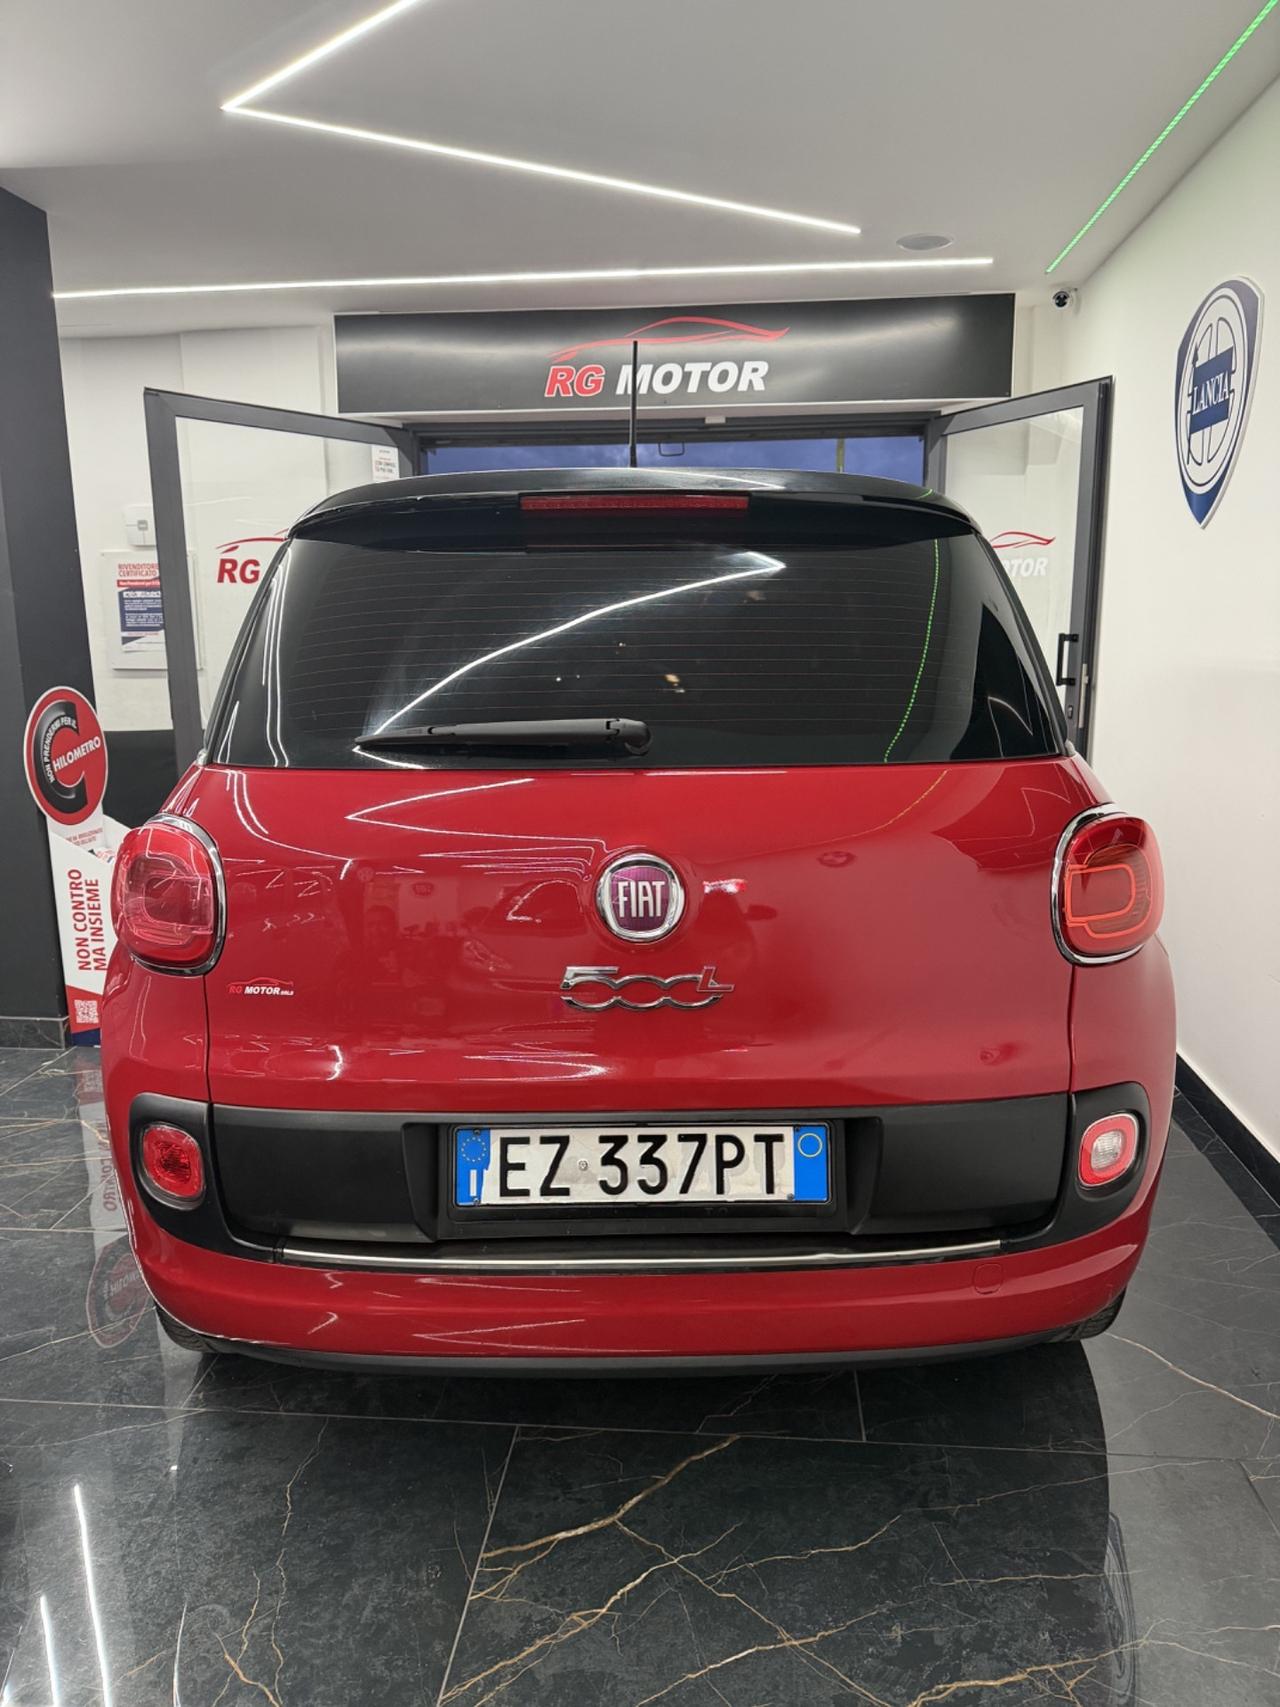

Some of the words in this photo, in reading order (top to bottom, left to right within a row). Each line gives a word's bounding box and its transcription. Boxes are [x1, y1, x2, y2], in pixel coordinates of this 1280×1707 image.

[545, 364, 606, 397] RG
[615, 361, 769, 395] MOTOR
[1192, 372, 1230, 414] LANCIA
[217, 558, 260, 584] RG
[53, 736, 101, 772] HILOMETRO
[68, 869, 87, 931] CONTRO
[85, 879, 103, 938] INSIEME
[617, 880, 665, 918] FIAT
[75, 937, 92, 971] NON
[94, 947, 107, 971] MA
[244, 986, 281, 995] MOTOR
[560, 965, 735, 1012] 500L
[500, 1135, 570, 1198] EZ
[597, 1133, 785, 1195] 337PT
